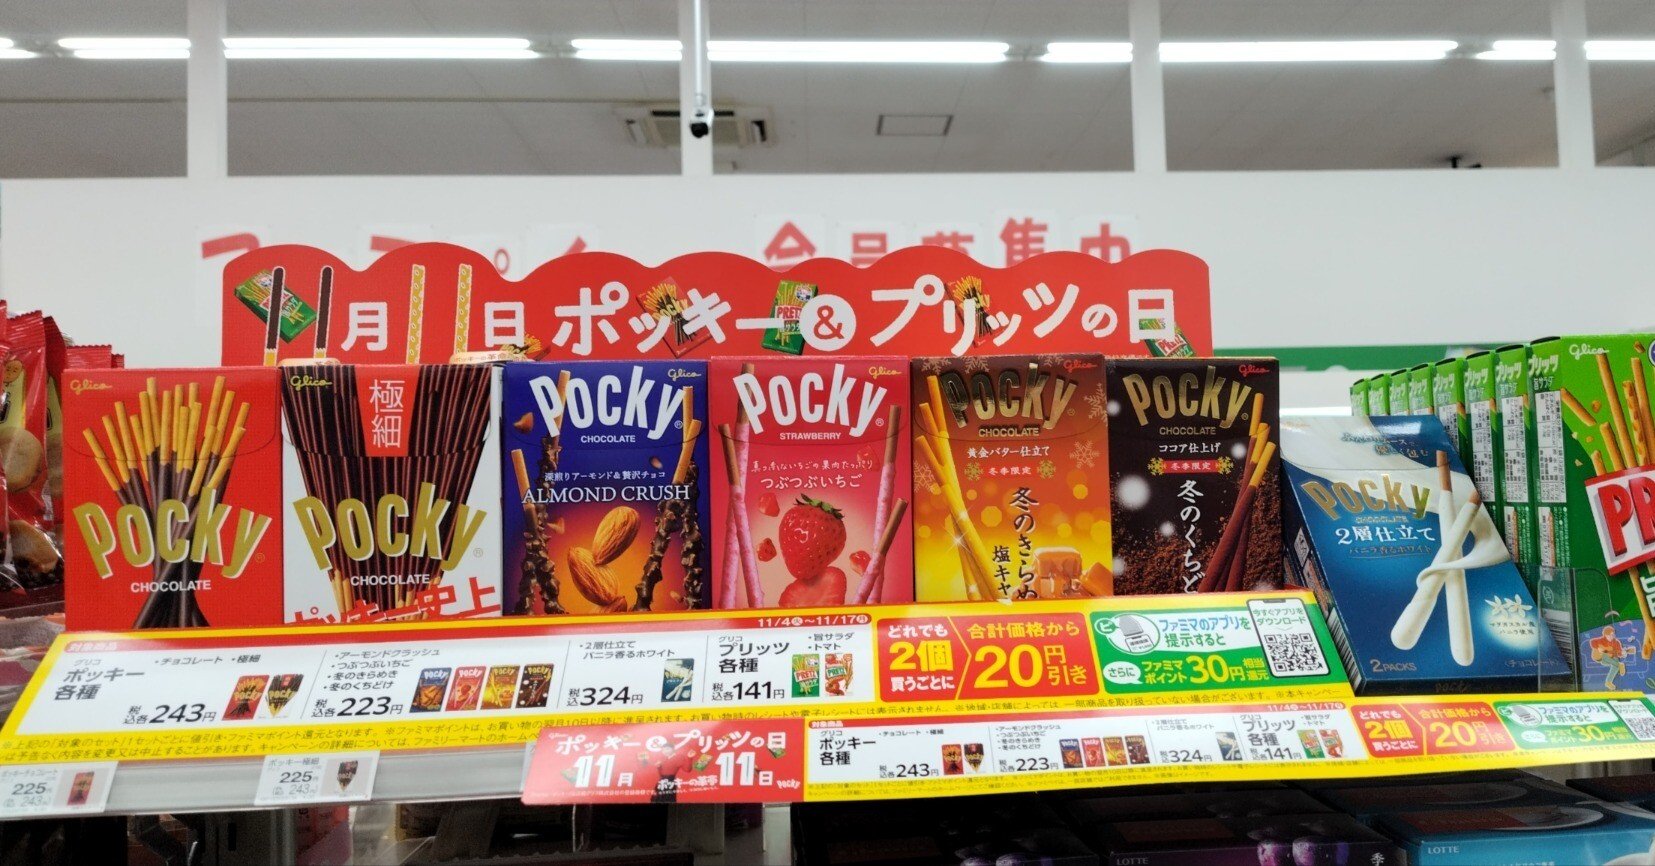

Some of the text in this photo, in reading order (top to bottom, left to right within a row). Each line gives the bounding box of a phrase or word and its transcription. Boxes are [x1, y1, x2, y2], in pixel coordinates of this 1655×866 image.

[1569, 344, 1609, 361] Glico
[668, 369, 702, 381] Glico
[869, 366, 903, 380] Glico
[70, 379, 112, 395] Glico
[290, 375, 332, 391] Glico
[369, 379, 405, 448] 極細
[580, 434, 636, 443] CHOCOLATE
[779, 432, 841, 440] STRAWBERRY
[978, 428, 1040, 438] CHOCOLATE
[1159, 427, 1217, 436] CHOCOLATE
[1159, 442, 1221, 453] ココア仕上げ
[760, 474, 863, 489] つぶつぶいちご
[521, 485, 691, 504] ALMOND CRUSH
[1335, 524, 1436, 545] 2層仕立て
[130, 579, 212, 594] CHOCOLATE
[350, 574, 430, 587] CHOCOLATE
[967, 621, 1080, 640] 合計価格から
[1159, 616, 1250, 631] ファミマのアプリを
[888, 624, 949, 639] どれでも
[1165, 633, 1226, 648] 提示すると
[719, 642, 790, 657] プリッツ
[889, 640, 953, 672] 2個
[719, 658, 758, 674] 各種
[1108, 667, 1135, 678] さらに
[63, 668, 146, 682] ポッキー
[890, 675, 955, 692] 買うごとに
[55, 684, 101, 700] 各種
[1359, 710, 1402, 720] どれでも
[1243, 719, 1296, 732] プリッツ
[1365, 720, 1413, 739] 2個
[820, 737, 876, 751] ポッキー
[1248, 732, 1280, 746] 各種
[1372, 740, 1418, 751] 買うごとに
[820, 751, 851, 766] 各種
[1428, 846, 1460, 854] LOTTE
